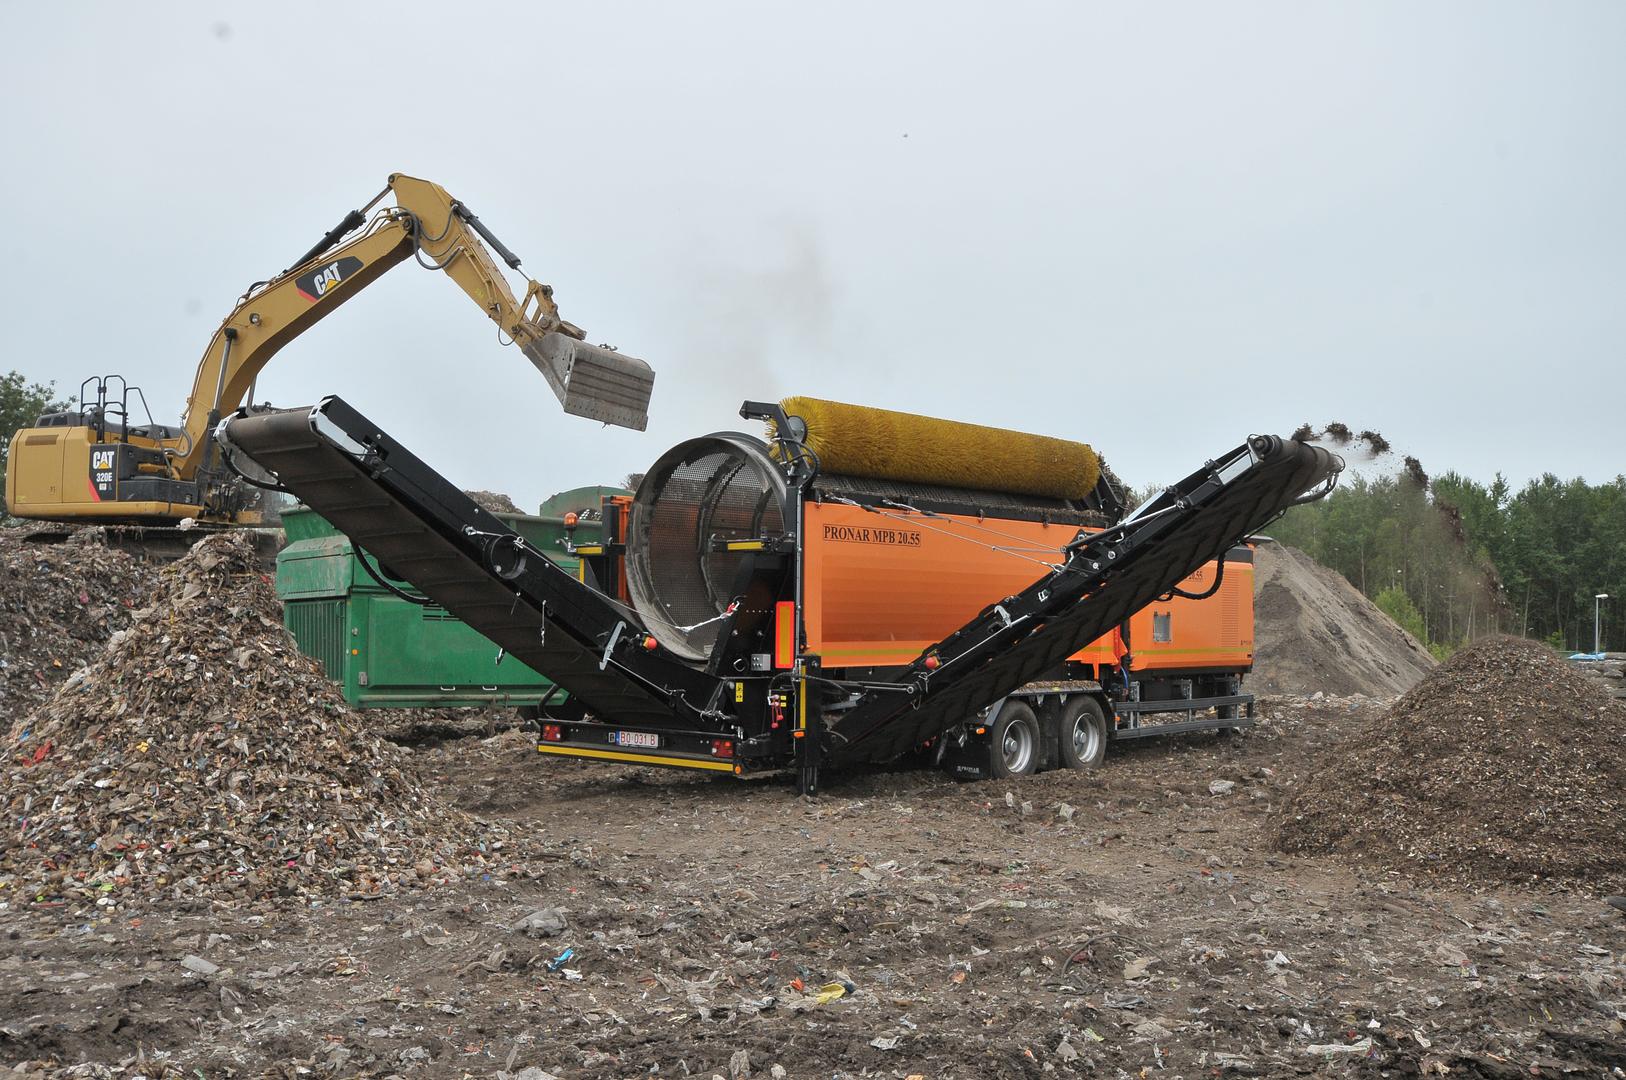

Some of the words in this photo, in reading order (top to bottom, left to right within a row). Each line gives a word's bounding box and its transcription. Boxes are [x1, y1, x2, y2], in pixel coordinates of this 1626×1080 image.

[314, 262, 341, 295] CAT
[93, 451, 114, 469] CAT
[96, 473, 112, 482] 320E
[824, 526, 870, 541] PRONAR
[872, 530, 895, 543] MPB
[898, 533, 920, 545] 20.55
